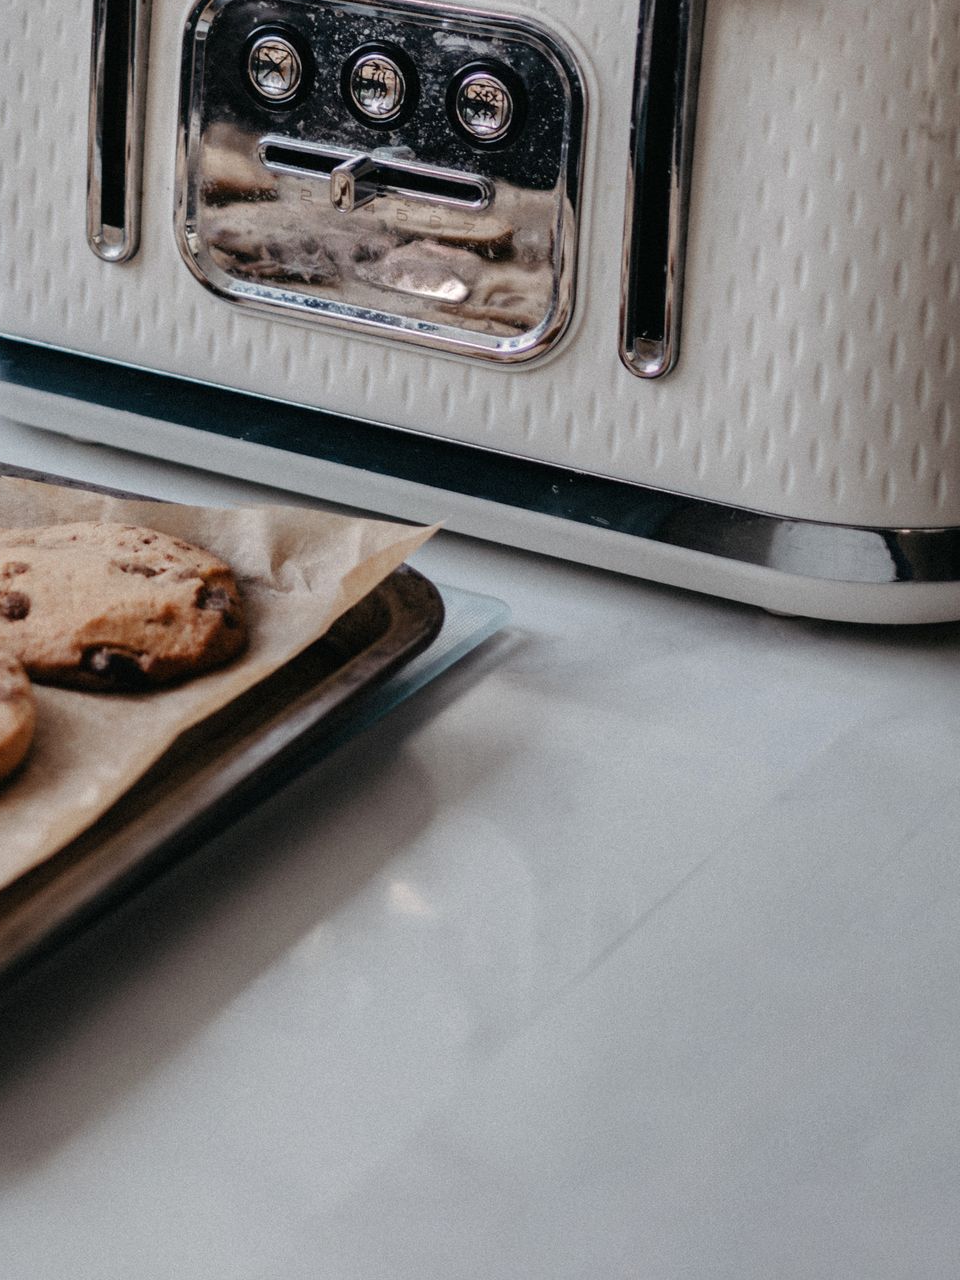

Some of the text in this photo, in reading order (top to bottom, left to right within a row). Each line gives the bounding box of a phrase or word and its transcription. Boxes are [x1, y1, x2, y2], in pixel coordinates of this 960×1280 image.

[301, 189, 313, 204] 2
[364, 203, 375, 214] 4
[396, 209, 409, 222] 5
[464, 222, 475, 234] 7
